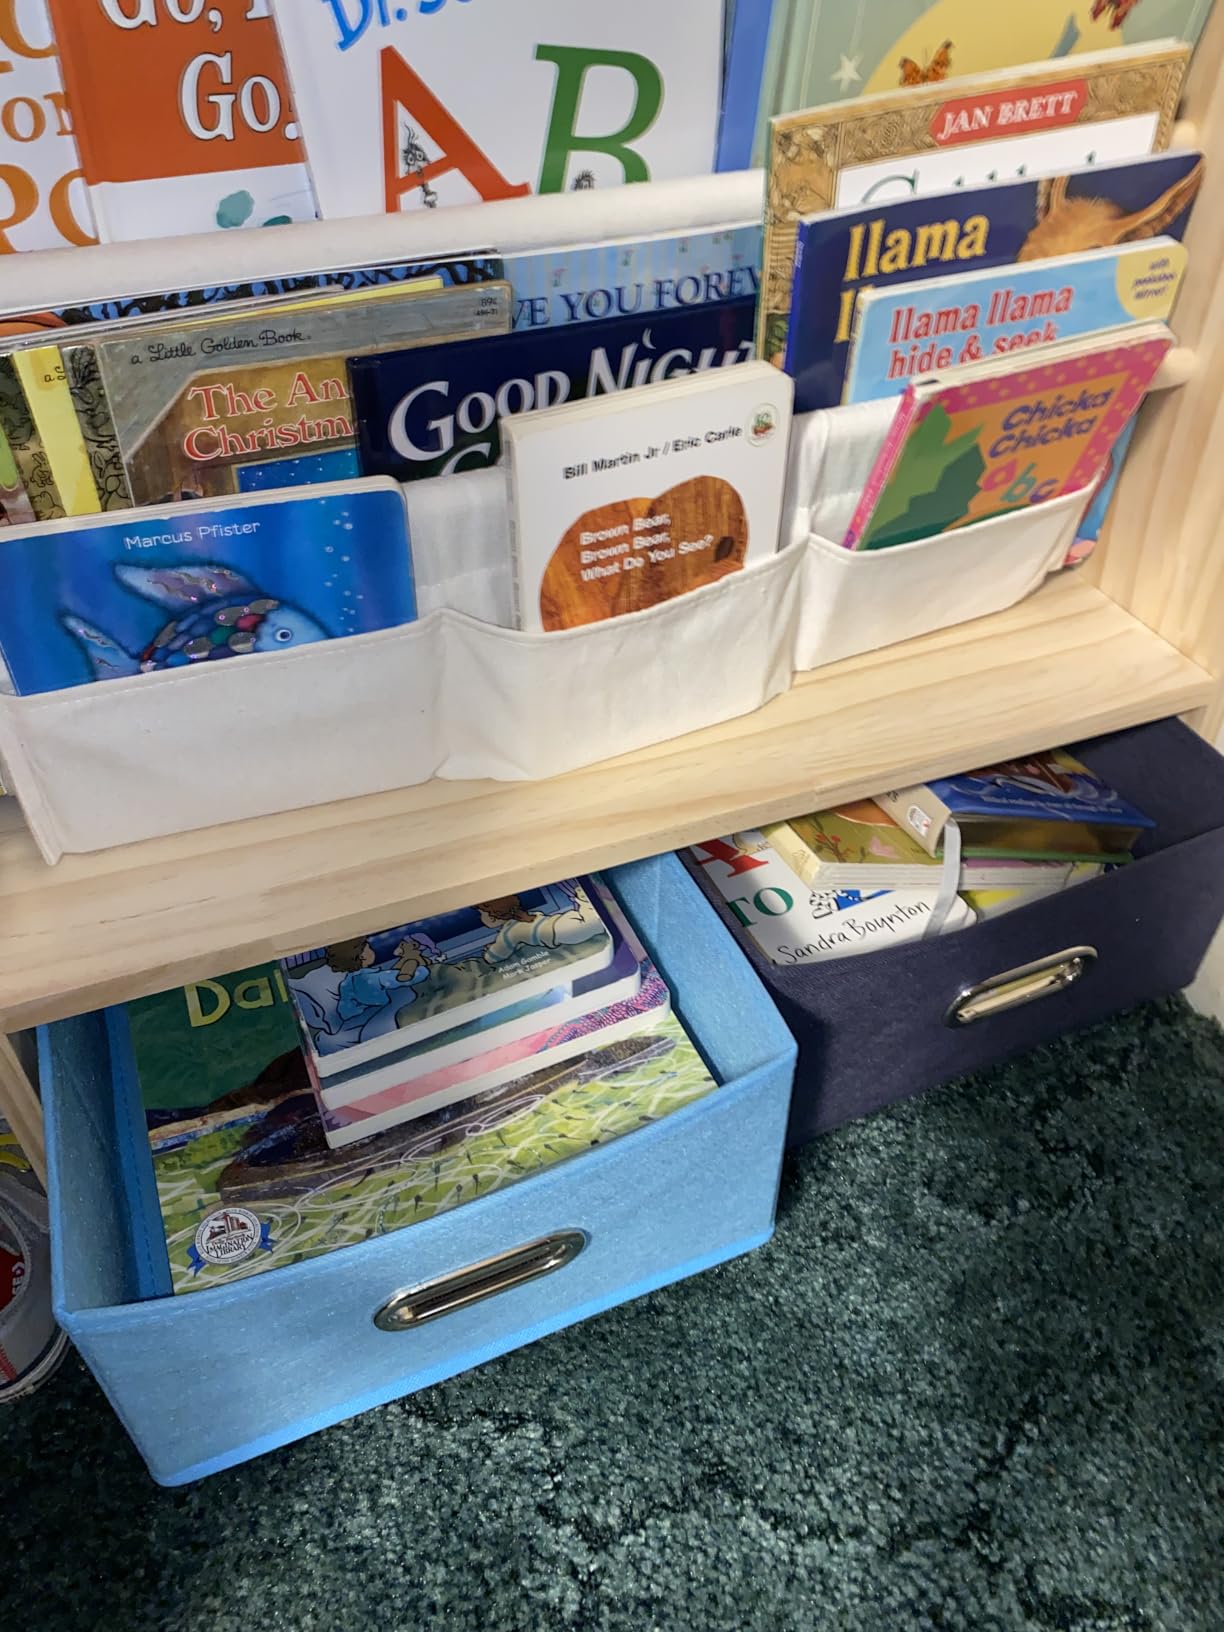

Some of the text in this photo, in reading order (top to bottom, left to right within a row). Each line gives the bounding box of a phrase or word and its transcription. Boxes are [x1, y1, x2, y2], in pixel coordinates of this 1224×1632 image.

[937, 90, 1079, 140] JAN BRETT
[843, 213, 991, 282] llama
[560, 284, 645, 322] YOU
[887, 302, 980, 344] llama
[986, 285, 1075, 326] llama
[130, 355, 142, 364] a
[147, 343, 197, 364] Little
[200, 334, 259, 355] Golden
[886, 322, 1059, 381] hide & seek
[188, 371, 351, 422] The An
[1002, 387, 1115, 433] Chicka
[183, 412, 355, 462] Christm
[563, 462, 588, 480] Bill
[592, 451, 640, 473] Martin
[644, 445, 660, 460] Jr
[672, 435, 702, 452] Eric
[705, 424, 743, 444] Carle
[988, 414, 1098, 459] Chicka
[124, 519, 262, 551] Marcus Pfister
[579, 512, 672, 546] Brown Bear,
[580, 532, 672, 564] Brown Bear,
[580, 534, 714, 582] What Do You See?
[777, 900, 931, 964] Sandra Boynton
[498, 951, 550, 974] Adam Gamble
[502, 958, 551, 979] Mark Jasper
